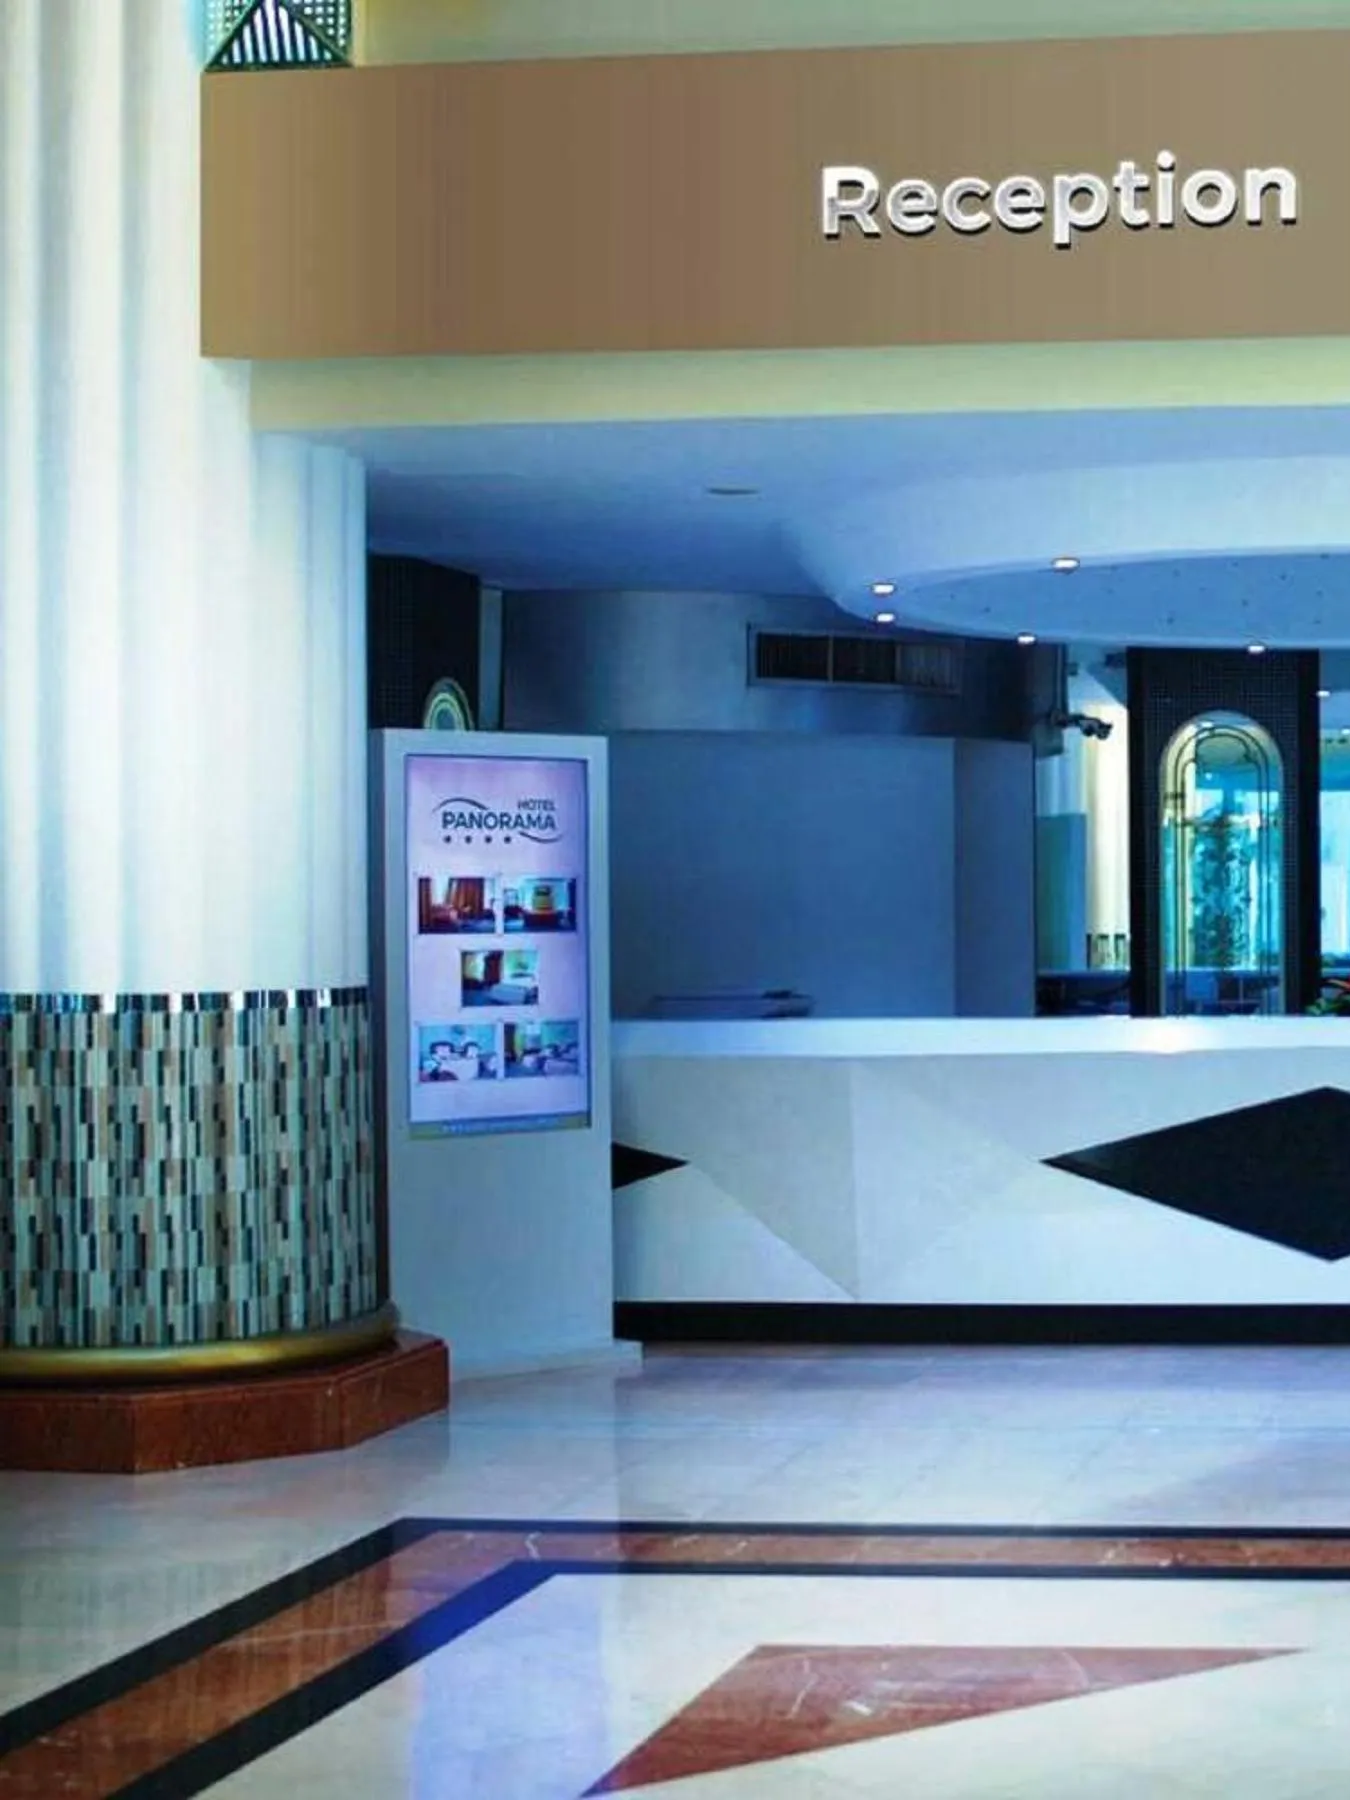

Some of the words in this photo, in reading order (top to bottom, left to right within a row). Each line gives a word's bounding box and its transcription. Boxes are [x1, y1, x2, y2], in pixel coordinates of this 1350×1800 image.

[821, 149, 1298, 249] Reception
[517, 799, 556, 812] HOTEL
[442, 811, 556, 830] PANORAMA
